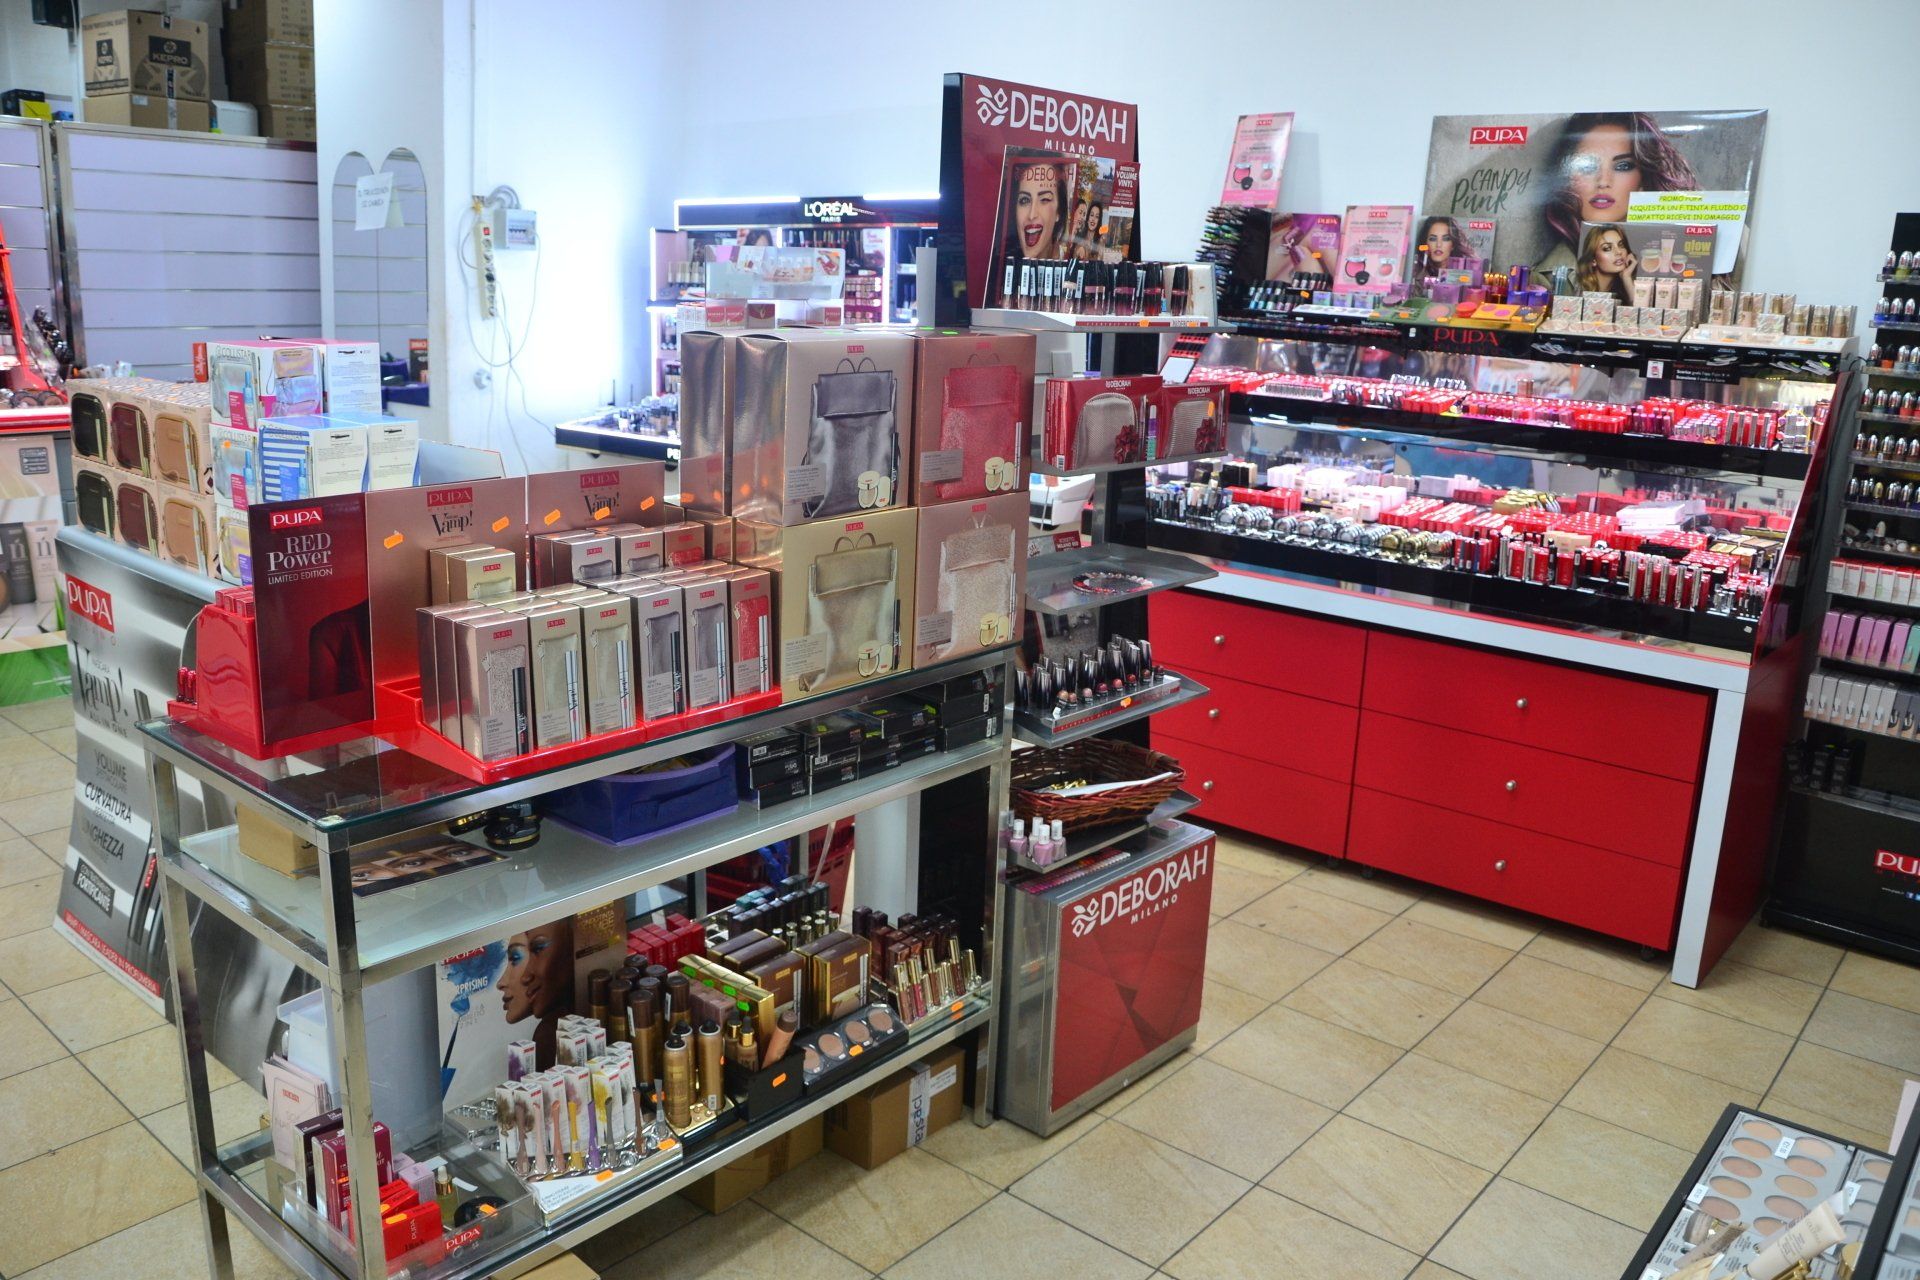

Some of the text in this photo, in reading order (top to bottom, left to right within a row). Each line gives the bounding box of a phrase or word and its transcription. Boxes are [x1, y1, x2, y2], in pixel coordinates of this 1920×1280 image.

[152, 53, 188, 66] KEPRO
[1010, 90, 1128, 144] DEBORAH
[1472, 128, 1525, 142] PUPA
[1044, 139, 1096, 155] MILANO
[1116, 171, 1138, 180] VOLUME
[1118, 179, 1134, 188] VINYL
[1450, 173, 1508, 214] Punk
[1470, 222, 1492, 230] PUPA
[1434, 328, 1498, 346] PUPA
[581, 472, 618, 488] PUPA
[430, 488, 472, 504] PUPA
[273, 510, 322, 526] PUPA
[432, 510, 473, 536] Vamp!
[284, 532, 332, 554] RED
[266, 550, 332, 572] Power
[268, 568, 332, 585] LIMITED EDITION
[68, 581, 113, 626] PUPA
[84, 782, 132, 824] CURVATURA
[1877, 852, 1920, 876] PU
[1101, 846, 1208, 926] DEBORAH
[1130, 894, 1178, 925] MILANO
[446, 1227, 481, 1250] PUPA
